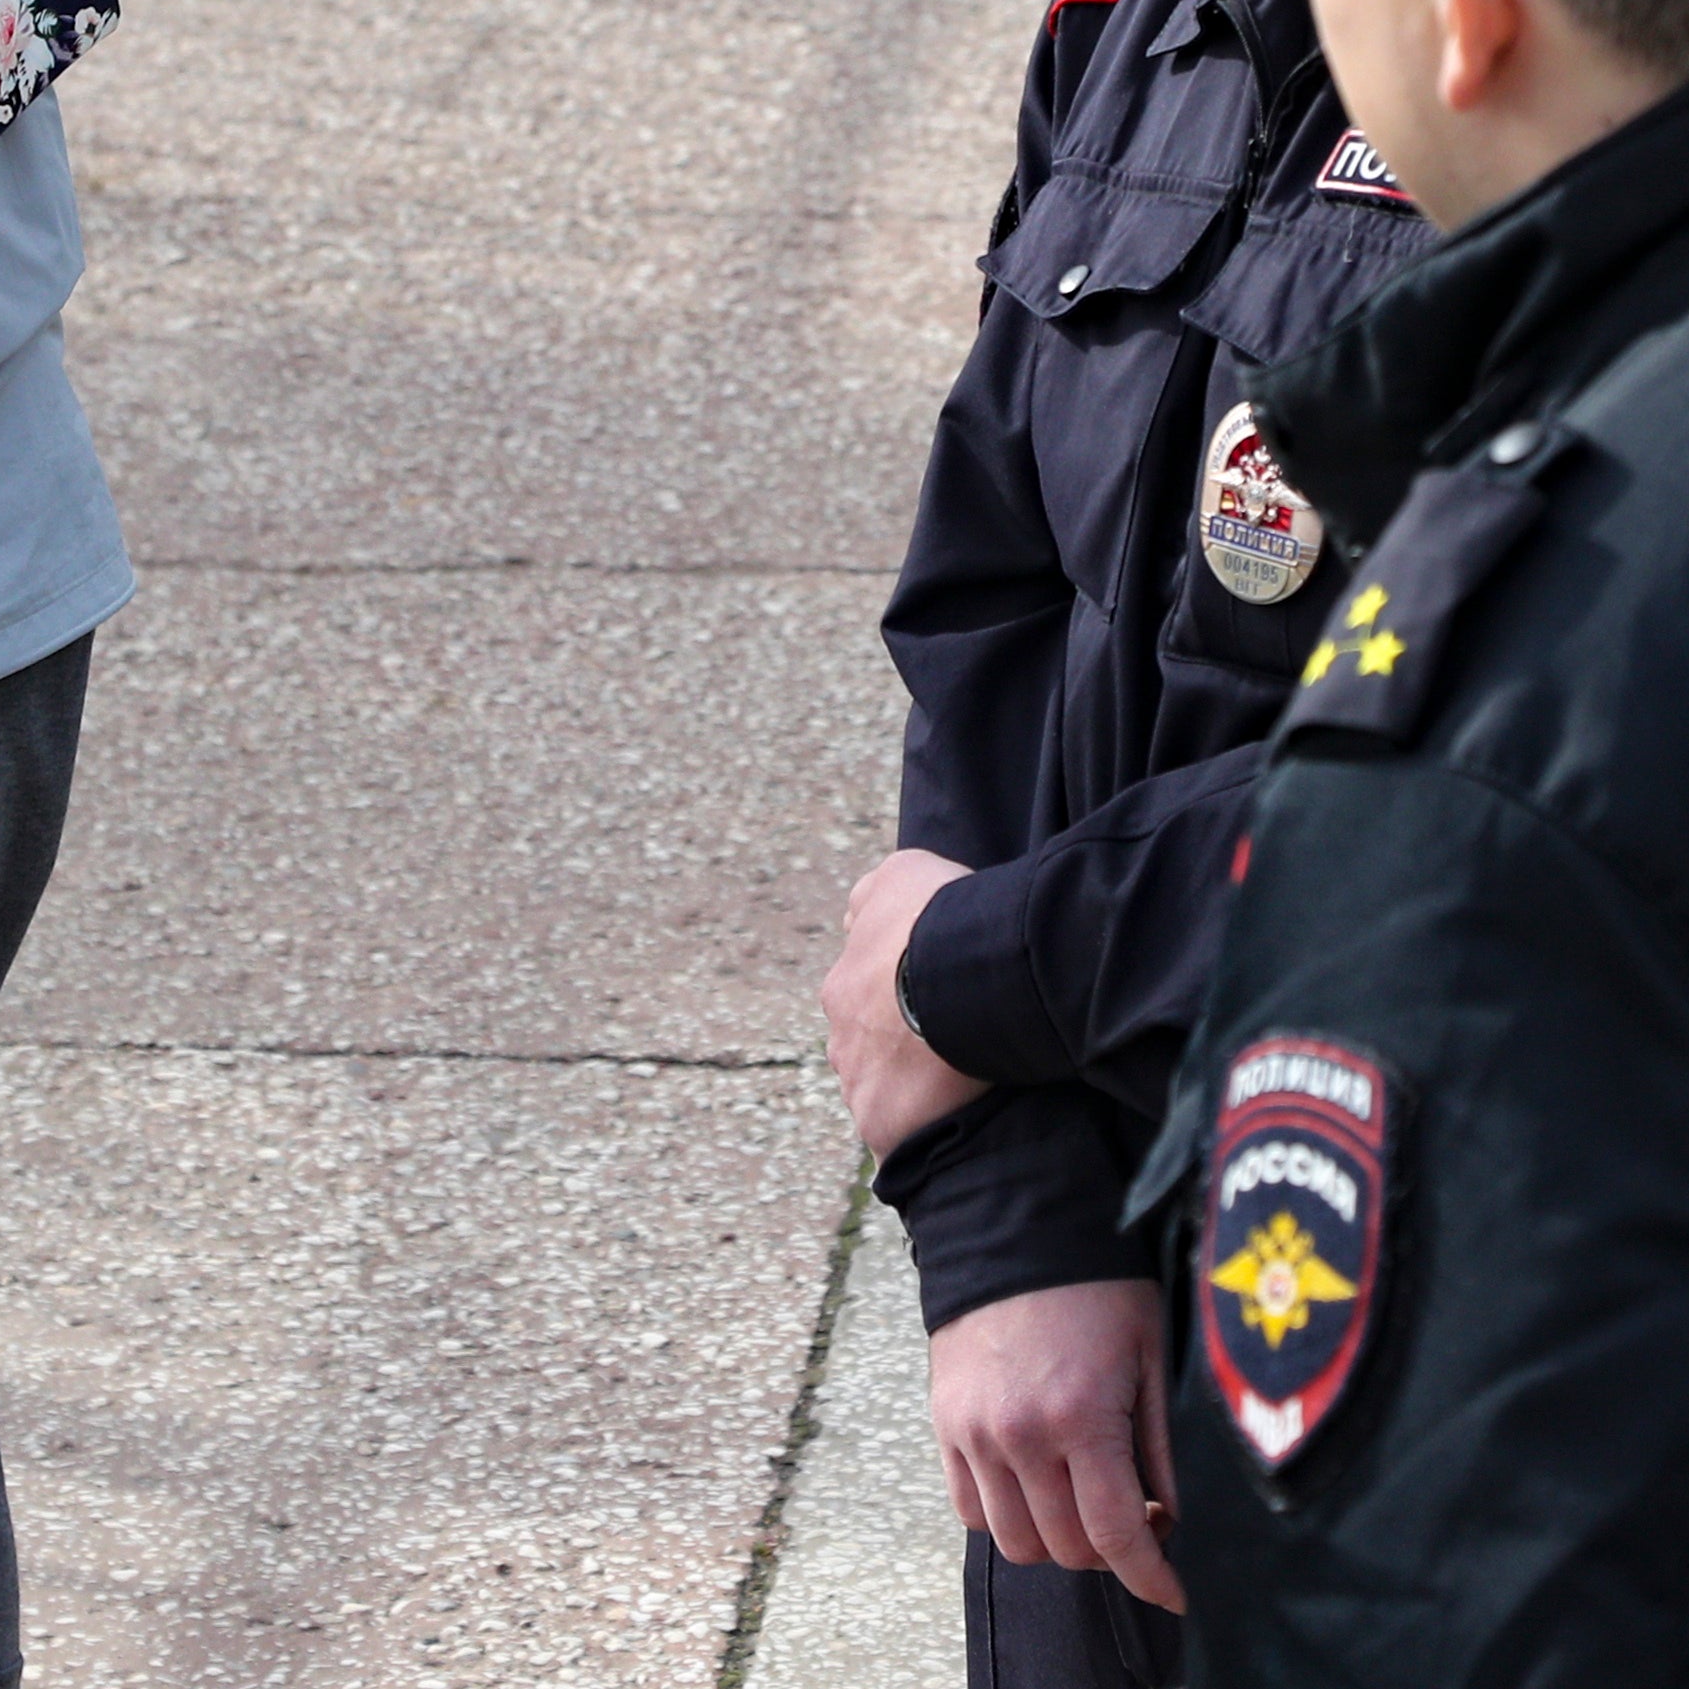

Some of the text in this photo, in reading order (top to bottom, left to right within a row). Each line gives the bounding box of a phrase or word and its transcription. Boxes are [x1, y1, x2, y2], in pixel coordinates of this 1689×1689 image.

[1332, 141, 1397, 183] ПО
[1211, 518, 1297, 561] ПОЛИЦИЯ
[1227, 1053, 1373, 1121] ПОЛИЦИЯ
[1220, 1140, 1358, 1223] РОССИЯ
